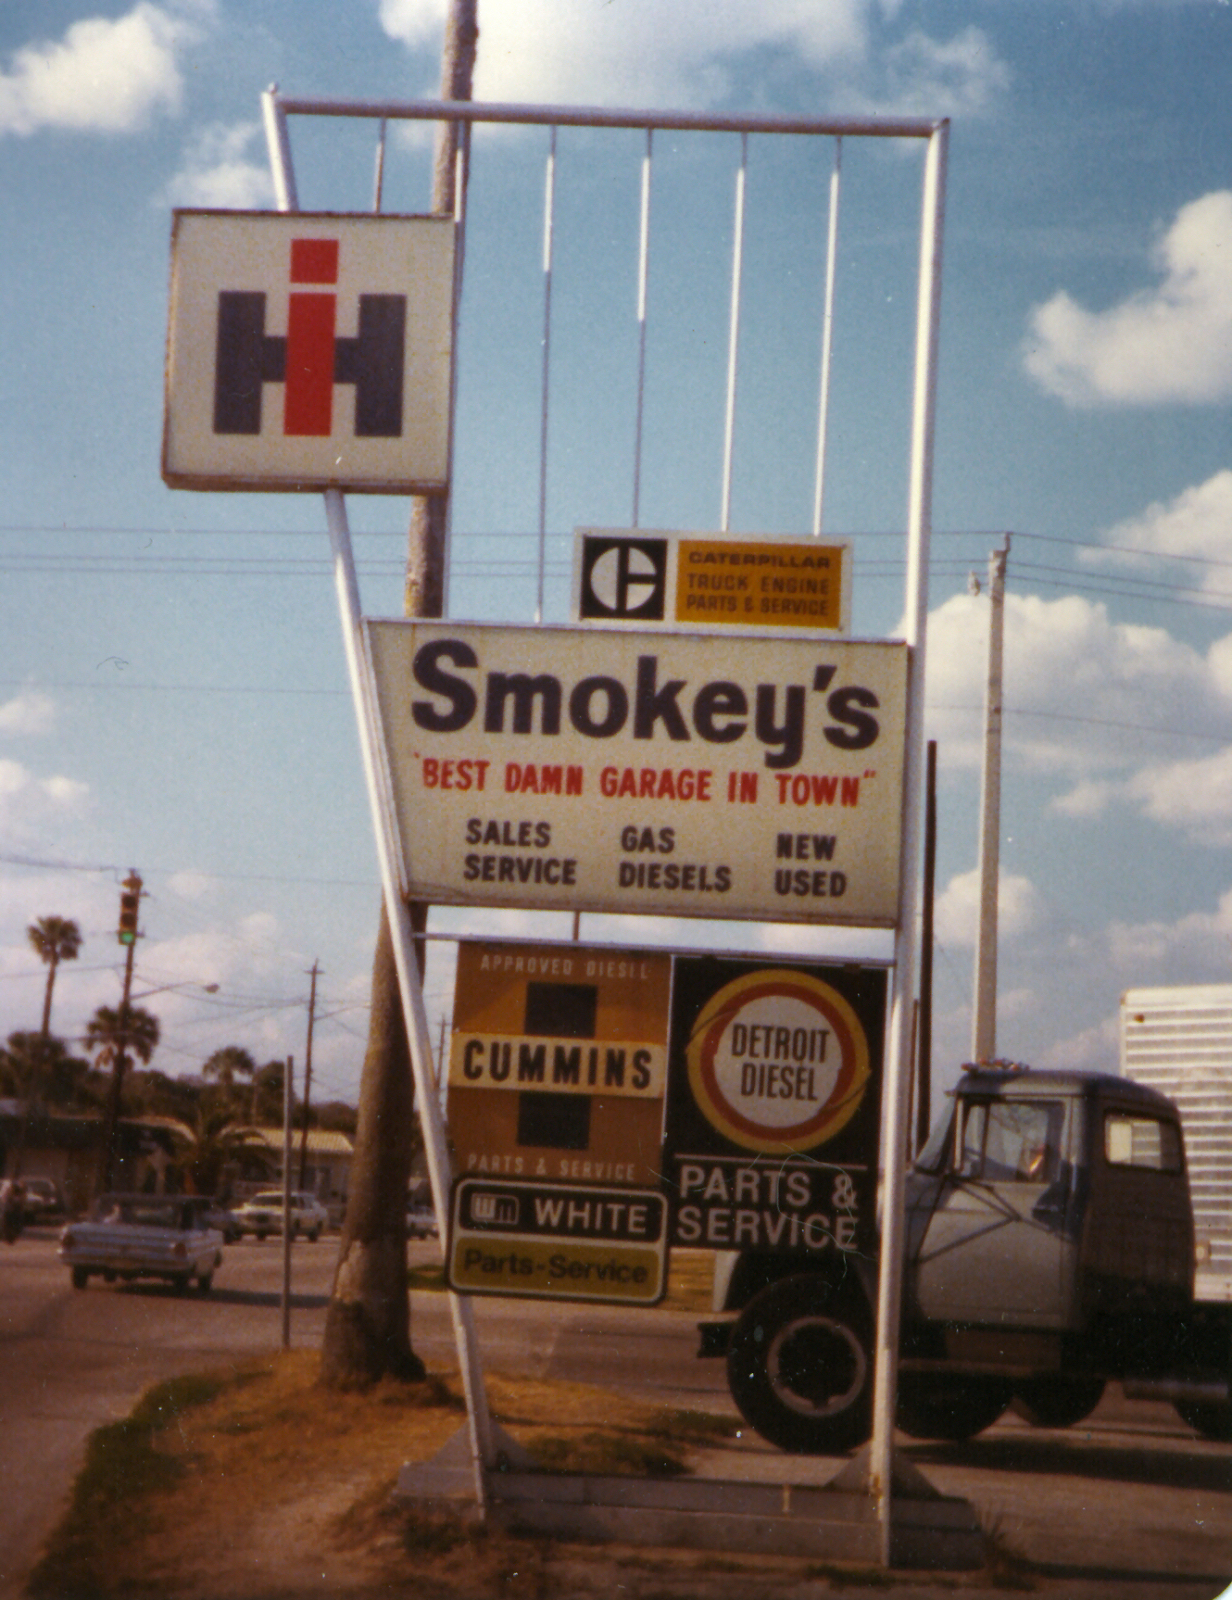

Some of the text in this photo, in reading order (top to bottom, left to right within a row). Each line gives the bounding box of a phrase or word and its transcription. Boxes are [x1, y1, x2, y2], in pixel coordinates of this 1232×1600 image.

[688, 551, 830, 569] CATERPILLAR
[687, 573, 830, 595] TRUCK ENGINE
[686, 594, 738, 612] PARTS
[760, 597, 829, 616] SERVICE
[411, 639, 881, 769] Smokey's
[504, 762, 584, 796] DAMN
[600, 766, 713, 801] GARAGE
[728, 772, 758, 804] IN
[465, 818, 551, 848] SALES
[621, 825, 676, 853] GAS
[776, 832, 837, 861] NEW
[463, 854, 577, 885] SERVICE
[618, 861, 732, 892] DIESELS
[774, 869, 848, 897] USED
[480, 954, 573, 975] APPROVED
[731, 1023, 831, 1064] DETROIT
[463, 1038, 653, 1090] CUMMINS
[741, 1062, 818, 1102] DIESEL
[467, 1154, 635, 1181] PARTS & SERVICE
[680, 1165, 859, 1210] PARTS &
[534, 1198, 649, 1233] WHITE
[677, 1206, 859, 1249] SERVICE
[463, 1249, 649, 1283] Parts-Service
